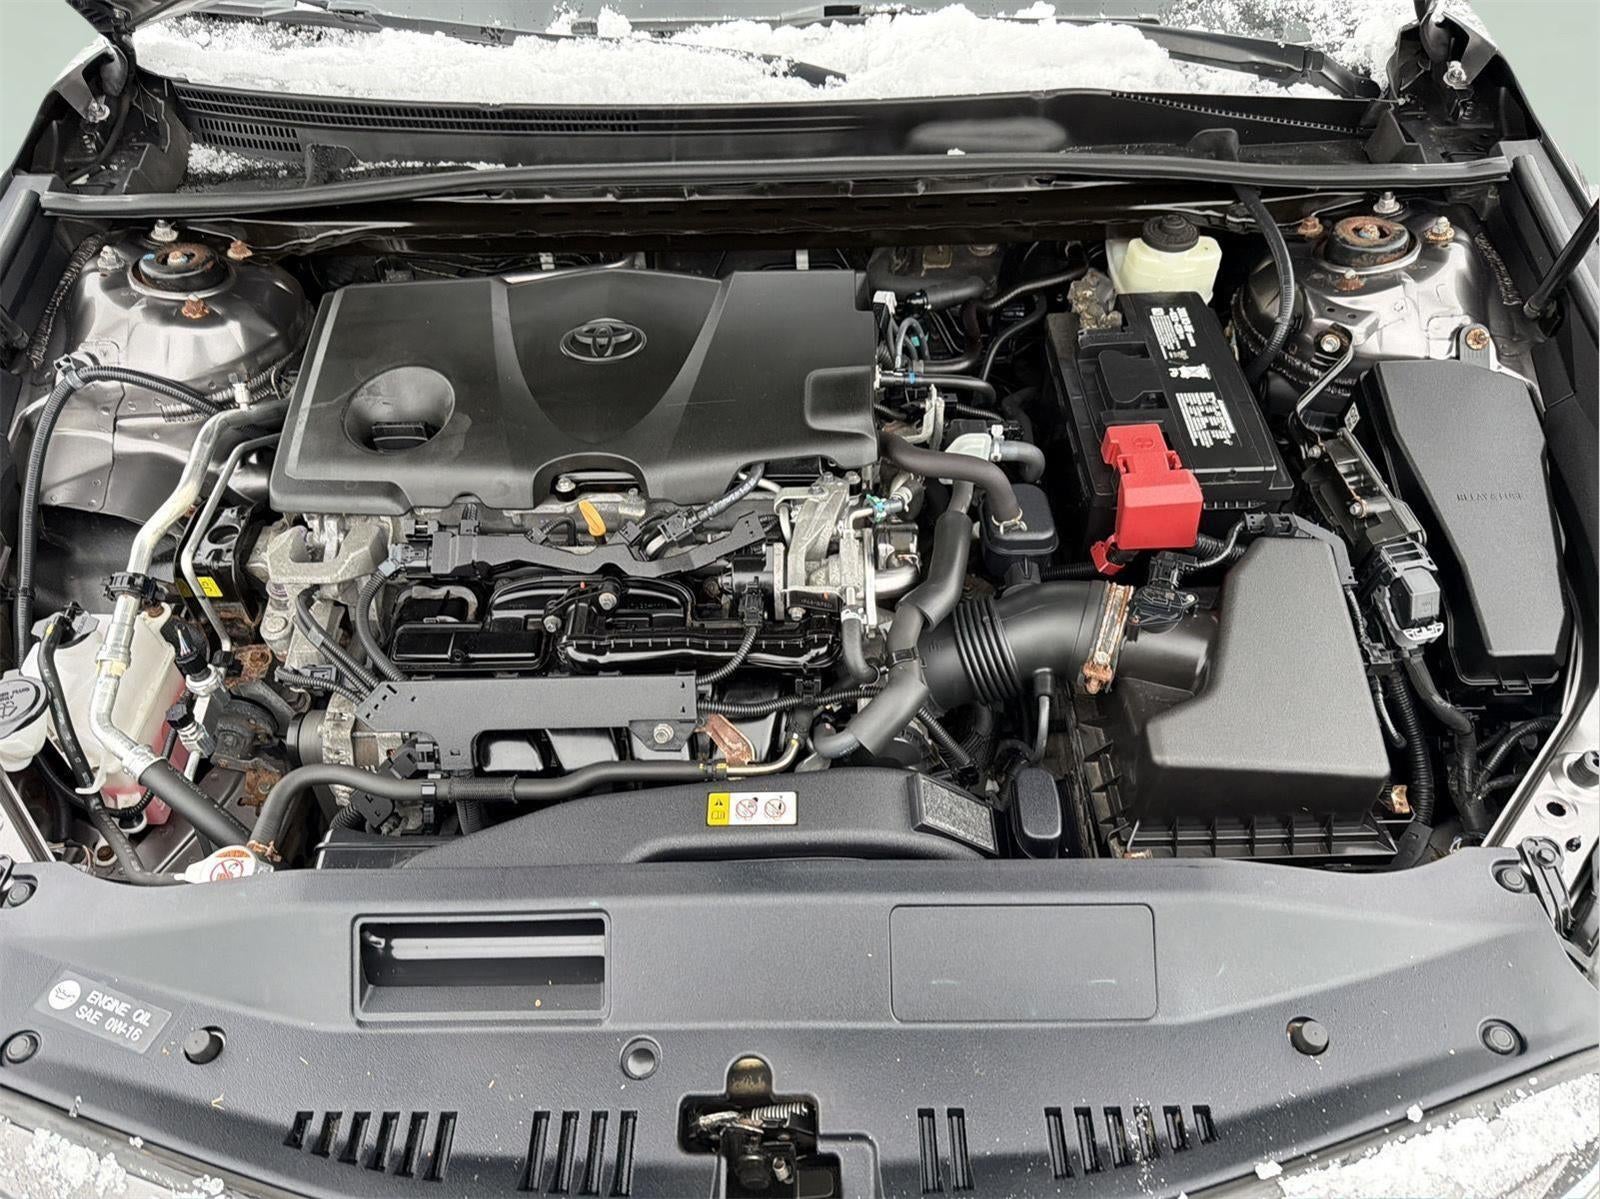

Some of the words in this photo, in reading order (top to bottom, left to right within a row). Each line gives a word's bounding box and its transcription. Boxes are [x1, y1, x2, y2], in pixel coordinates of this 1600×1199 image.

[75, 1004, 103, 1025] SAE
[104, 1017, 143, 1042] 0W-16
[86, 990, 131, 1017] ENGINE
[132, 1008, 152, 1027] OIL
